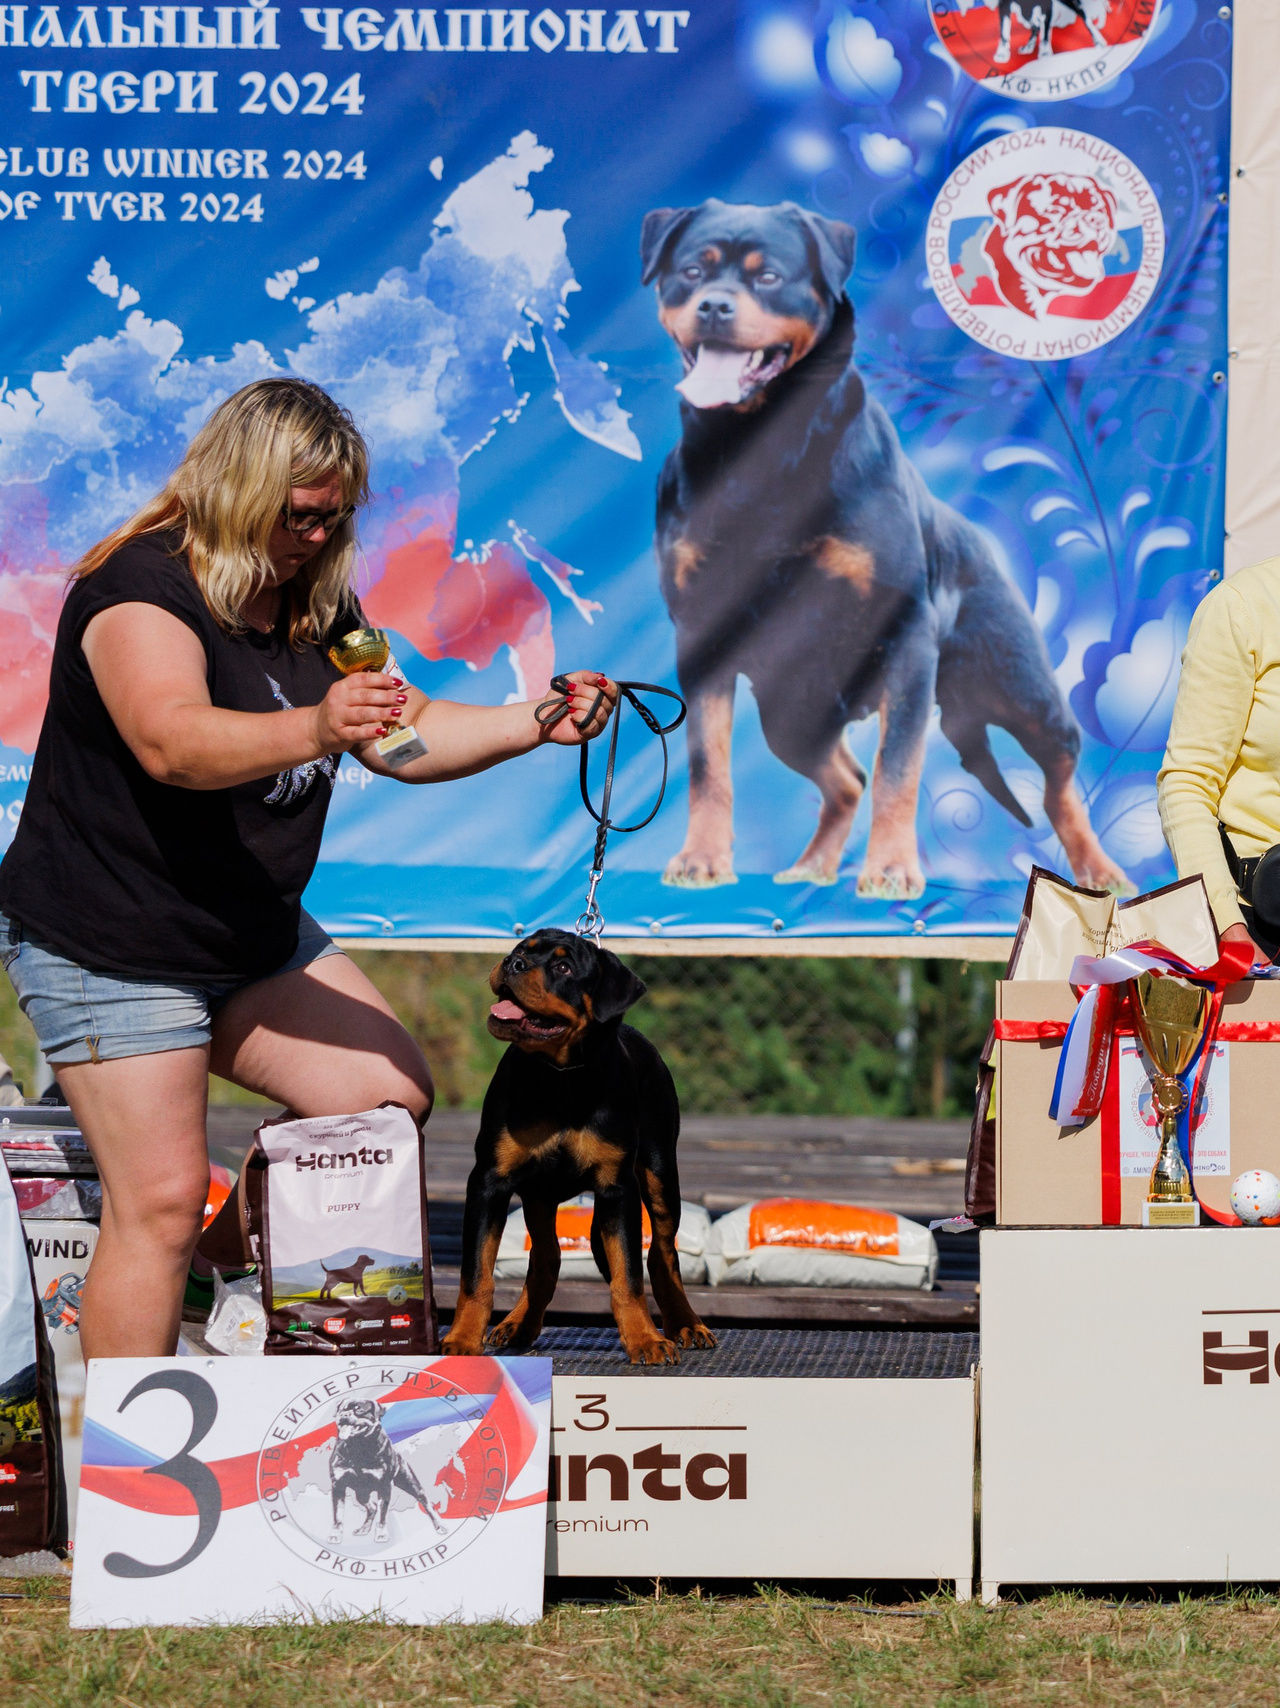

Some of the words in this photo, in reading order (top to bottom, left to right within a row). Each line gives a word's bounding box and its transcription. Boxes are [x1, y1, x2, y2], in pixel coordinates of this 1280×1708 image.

[303, 8, 690, 54] ЧЕМПИОНАТ
[20, 70, 219, 114] ТВЕРИ
[239, 72, 366, 116] 2024
[985, 60, 1108, 95] РКФ-НКПР
[104, 149, 268, 179] WINNER
[283, 150, 367, 181] 2024
[931, 147, 995, 230] РОССИИ
[999, 131, 1047, 156] 2024
[54, 191, 166, 222] TVER
[180, 192, 264, 223] 2024
[295, 1146, 394, 1173] Hanta
[327, 1203, 361, 1213] PUPPY
[573, 1394, 610, 1432] 3
[264, 1371, 363, 1523] РОТВЕЙЛЕР
[379, 1369, 461, 1406] КЛУБ
[468, 1409, 506, 1523] РОССИИ
[103, 1369, 223, 1579] 3
[547, 1443, 747, 1501] nta
[547, 1516, 649, 1532] remium
[314, 1544, 450, 1578] РКФ-НКПР
